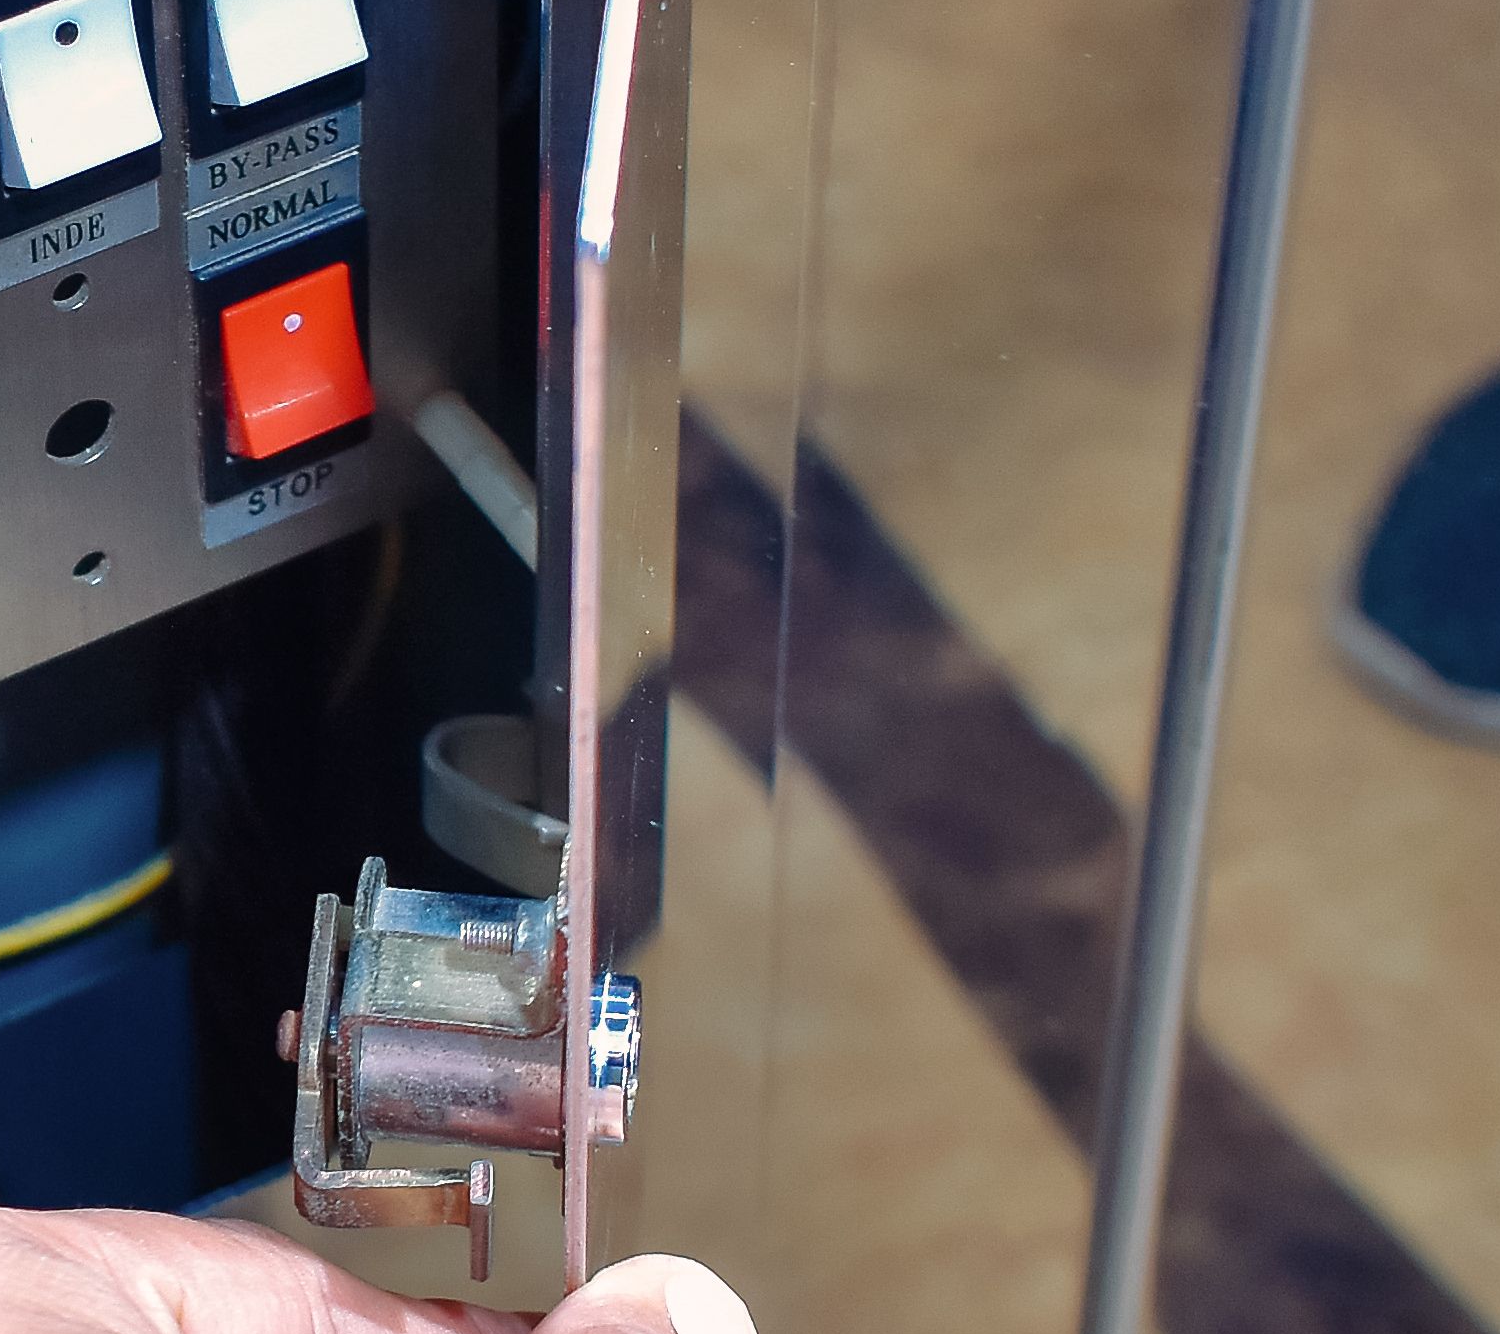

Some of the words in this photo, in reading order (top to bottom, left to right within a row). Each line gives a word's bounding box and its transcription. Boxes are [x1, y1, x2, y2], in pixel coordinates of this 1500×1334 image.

[208, 118, 340, 190] BY-PASS
[30, 211, 106, 265] INDE
[207, 179, 338, 250] NORMAL
[247, 461, 334, 516] STOP
